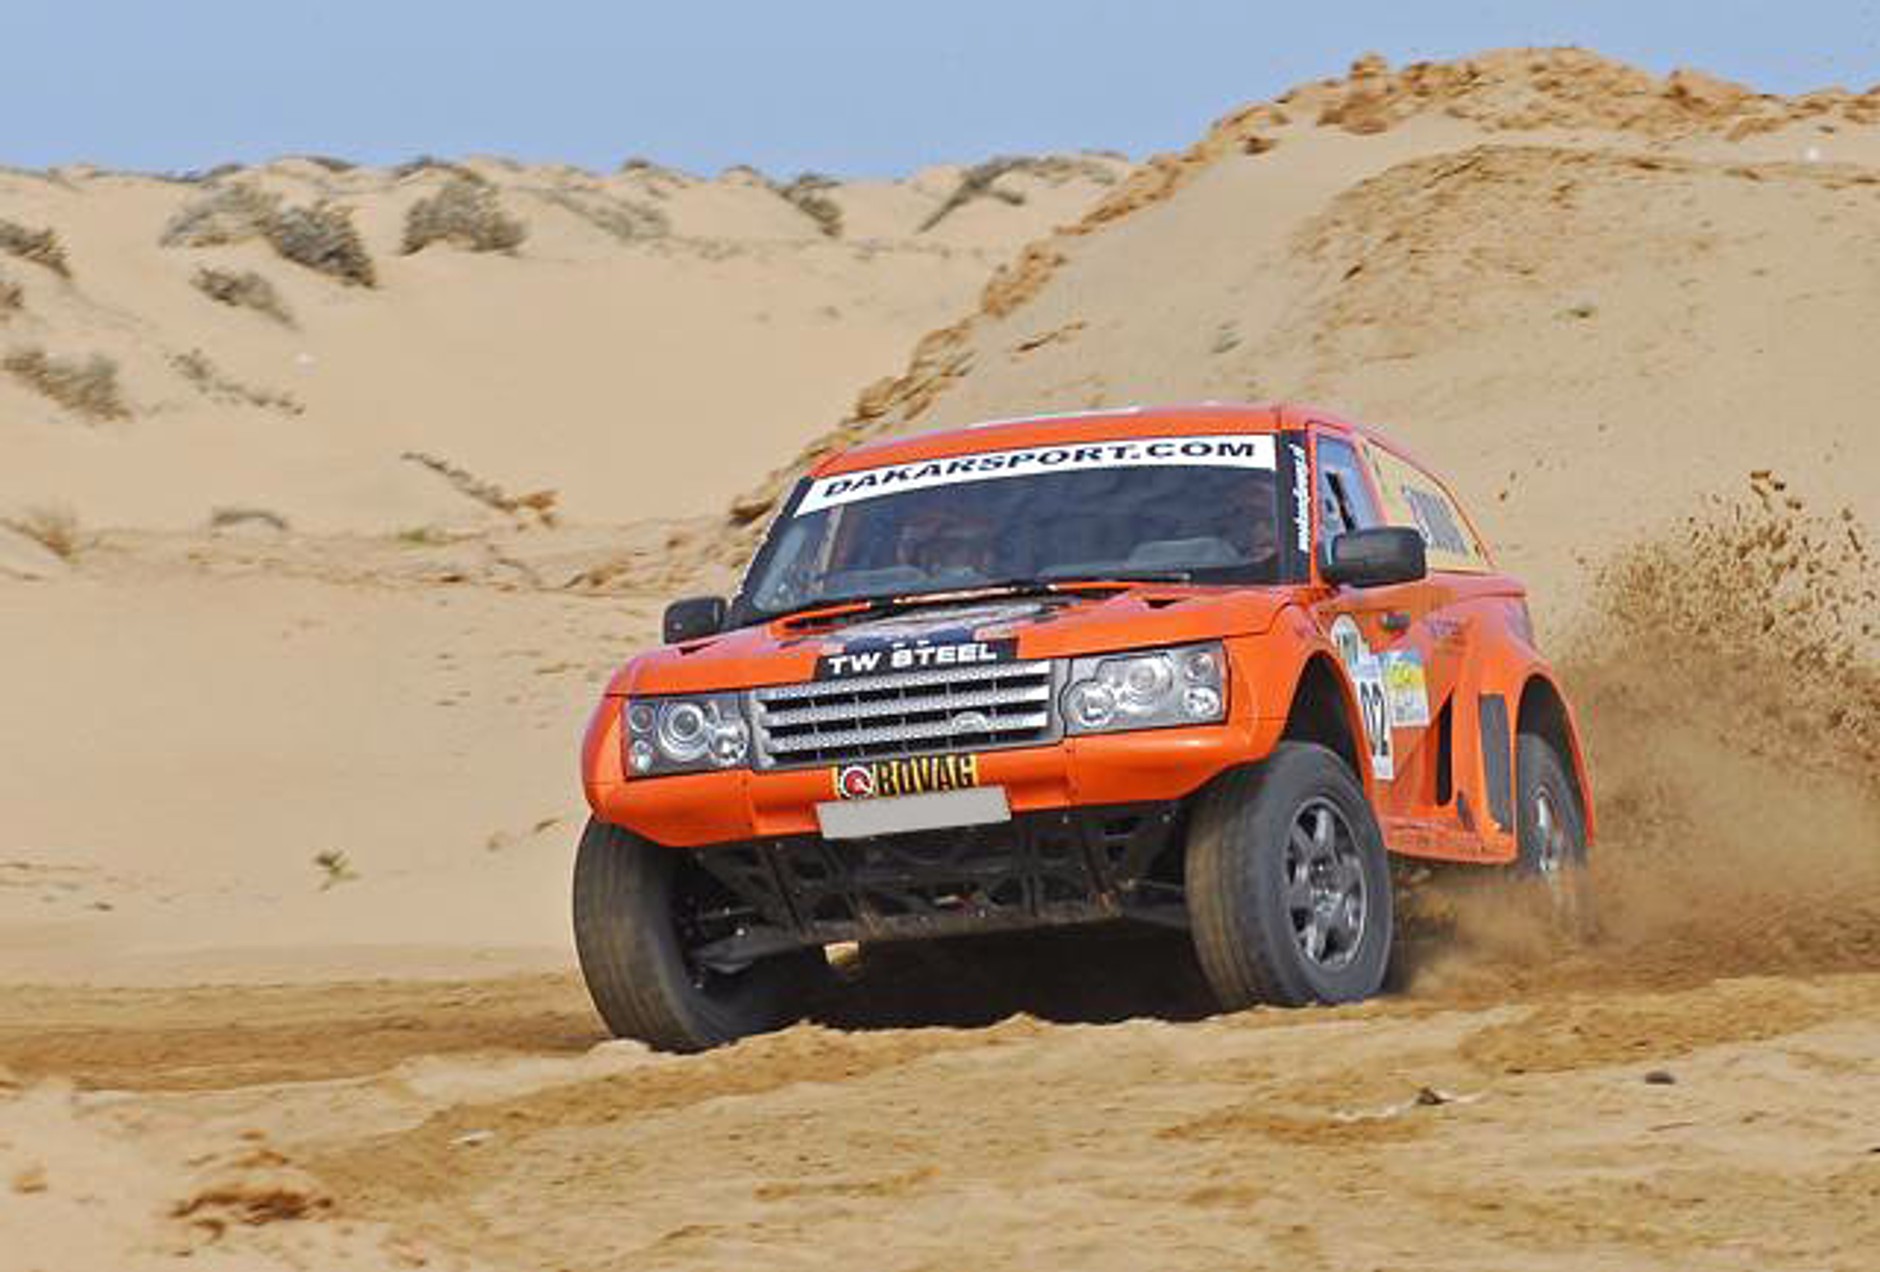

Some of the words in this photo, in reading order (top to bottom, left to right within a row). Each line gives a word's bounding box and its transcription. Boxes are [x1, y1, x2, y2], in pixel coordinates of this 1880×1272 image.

[822, 441, 1255, 498] DAKARSPORT.COM
[827, 652, 881, 674] TW
[890, 643, 997, 669] STEEL
